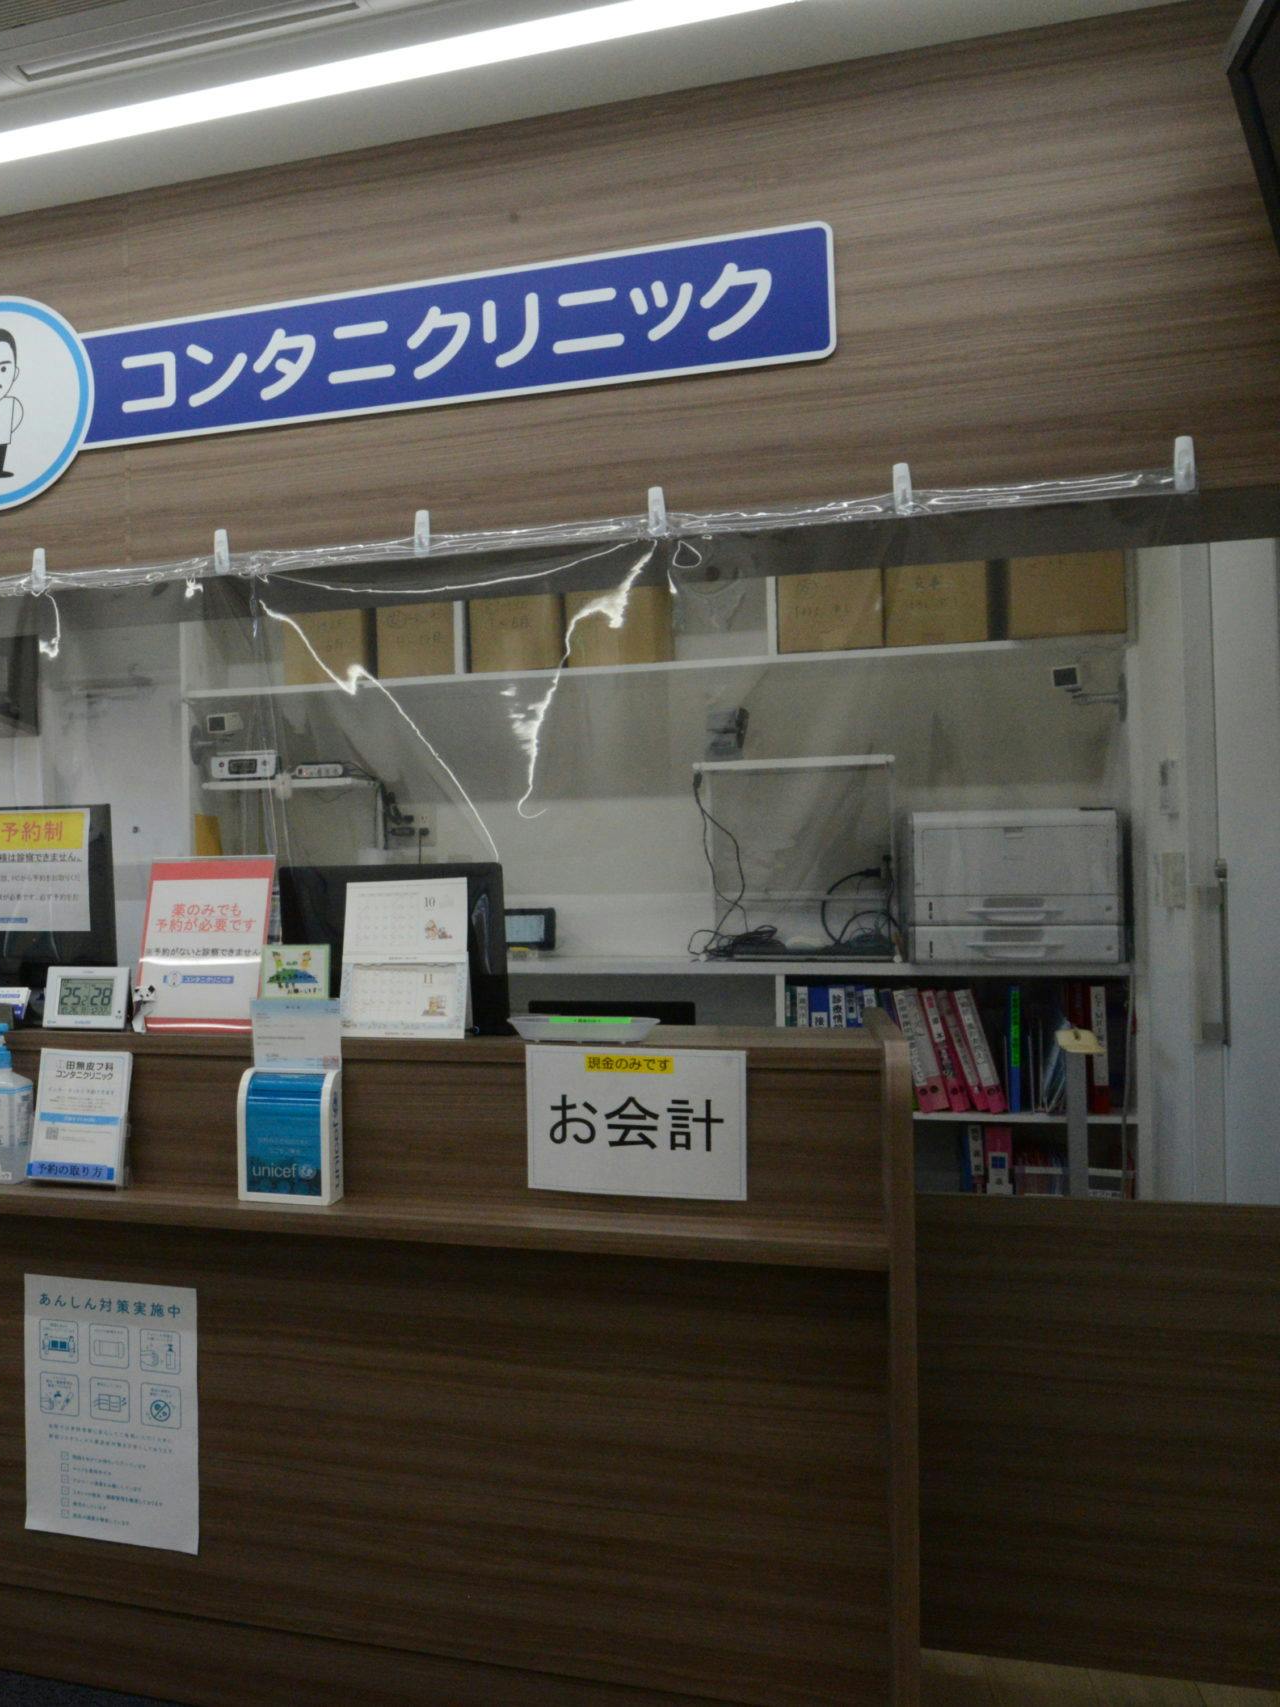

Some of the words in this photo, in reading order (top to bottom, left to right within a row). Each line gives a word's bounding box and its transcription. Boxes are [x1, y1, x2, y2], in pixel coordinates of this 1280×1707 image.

[122, 261, 772, 414] コンタニクリニック
[171, 903, 242, 917] 薬のみでも
[424, 896, 436, 908] 10
[155, 918, 256, 933] 予約が必要です
[587, 1056, 670, 1071] 現金のみです
[55, 1070, 113, 1080] コンタニクリニック
[549, 1093, 724, 1153] お会計
[37, 1161, 105, 1179] 予約の取り方
[252, 1162, 298, 1179] unicef
[39, 1292, 182, 1319] あんしん対策実施中
